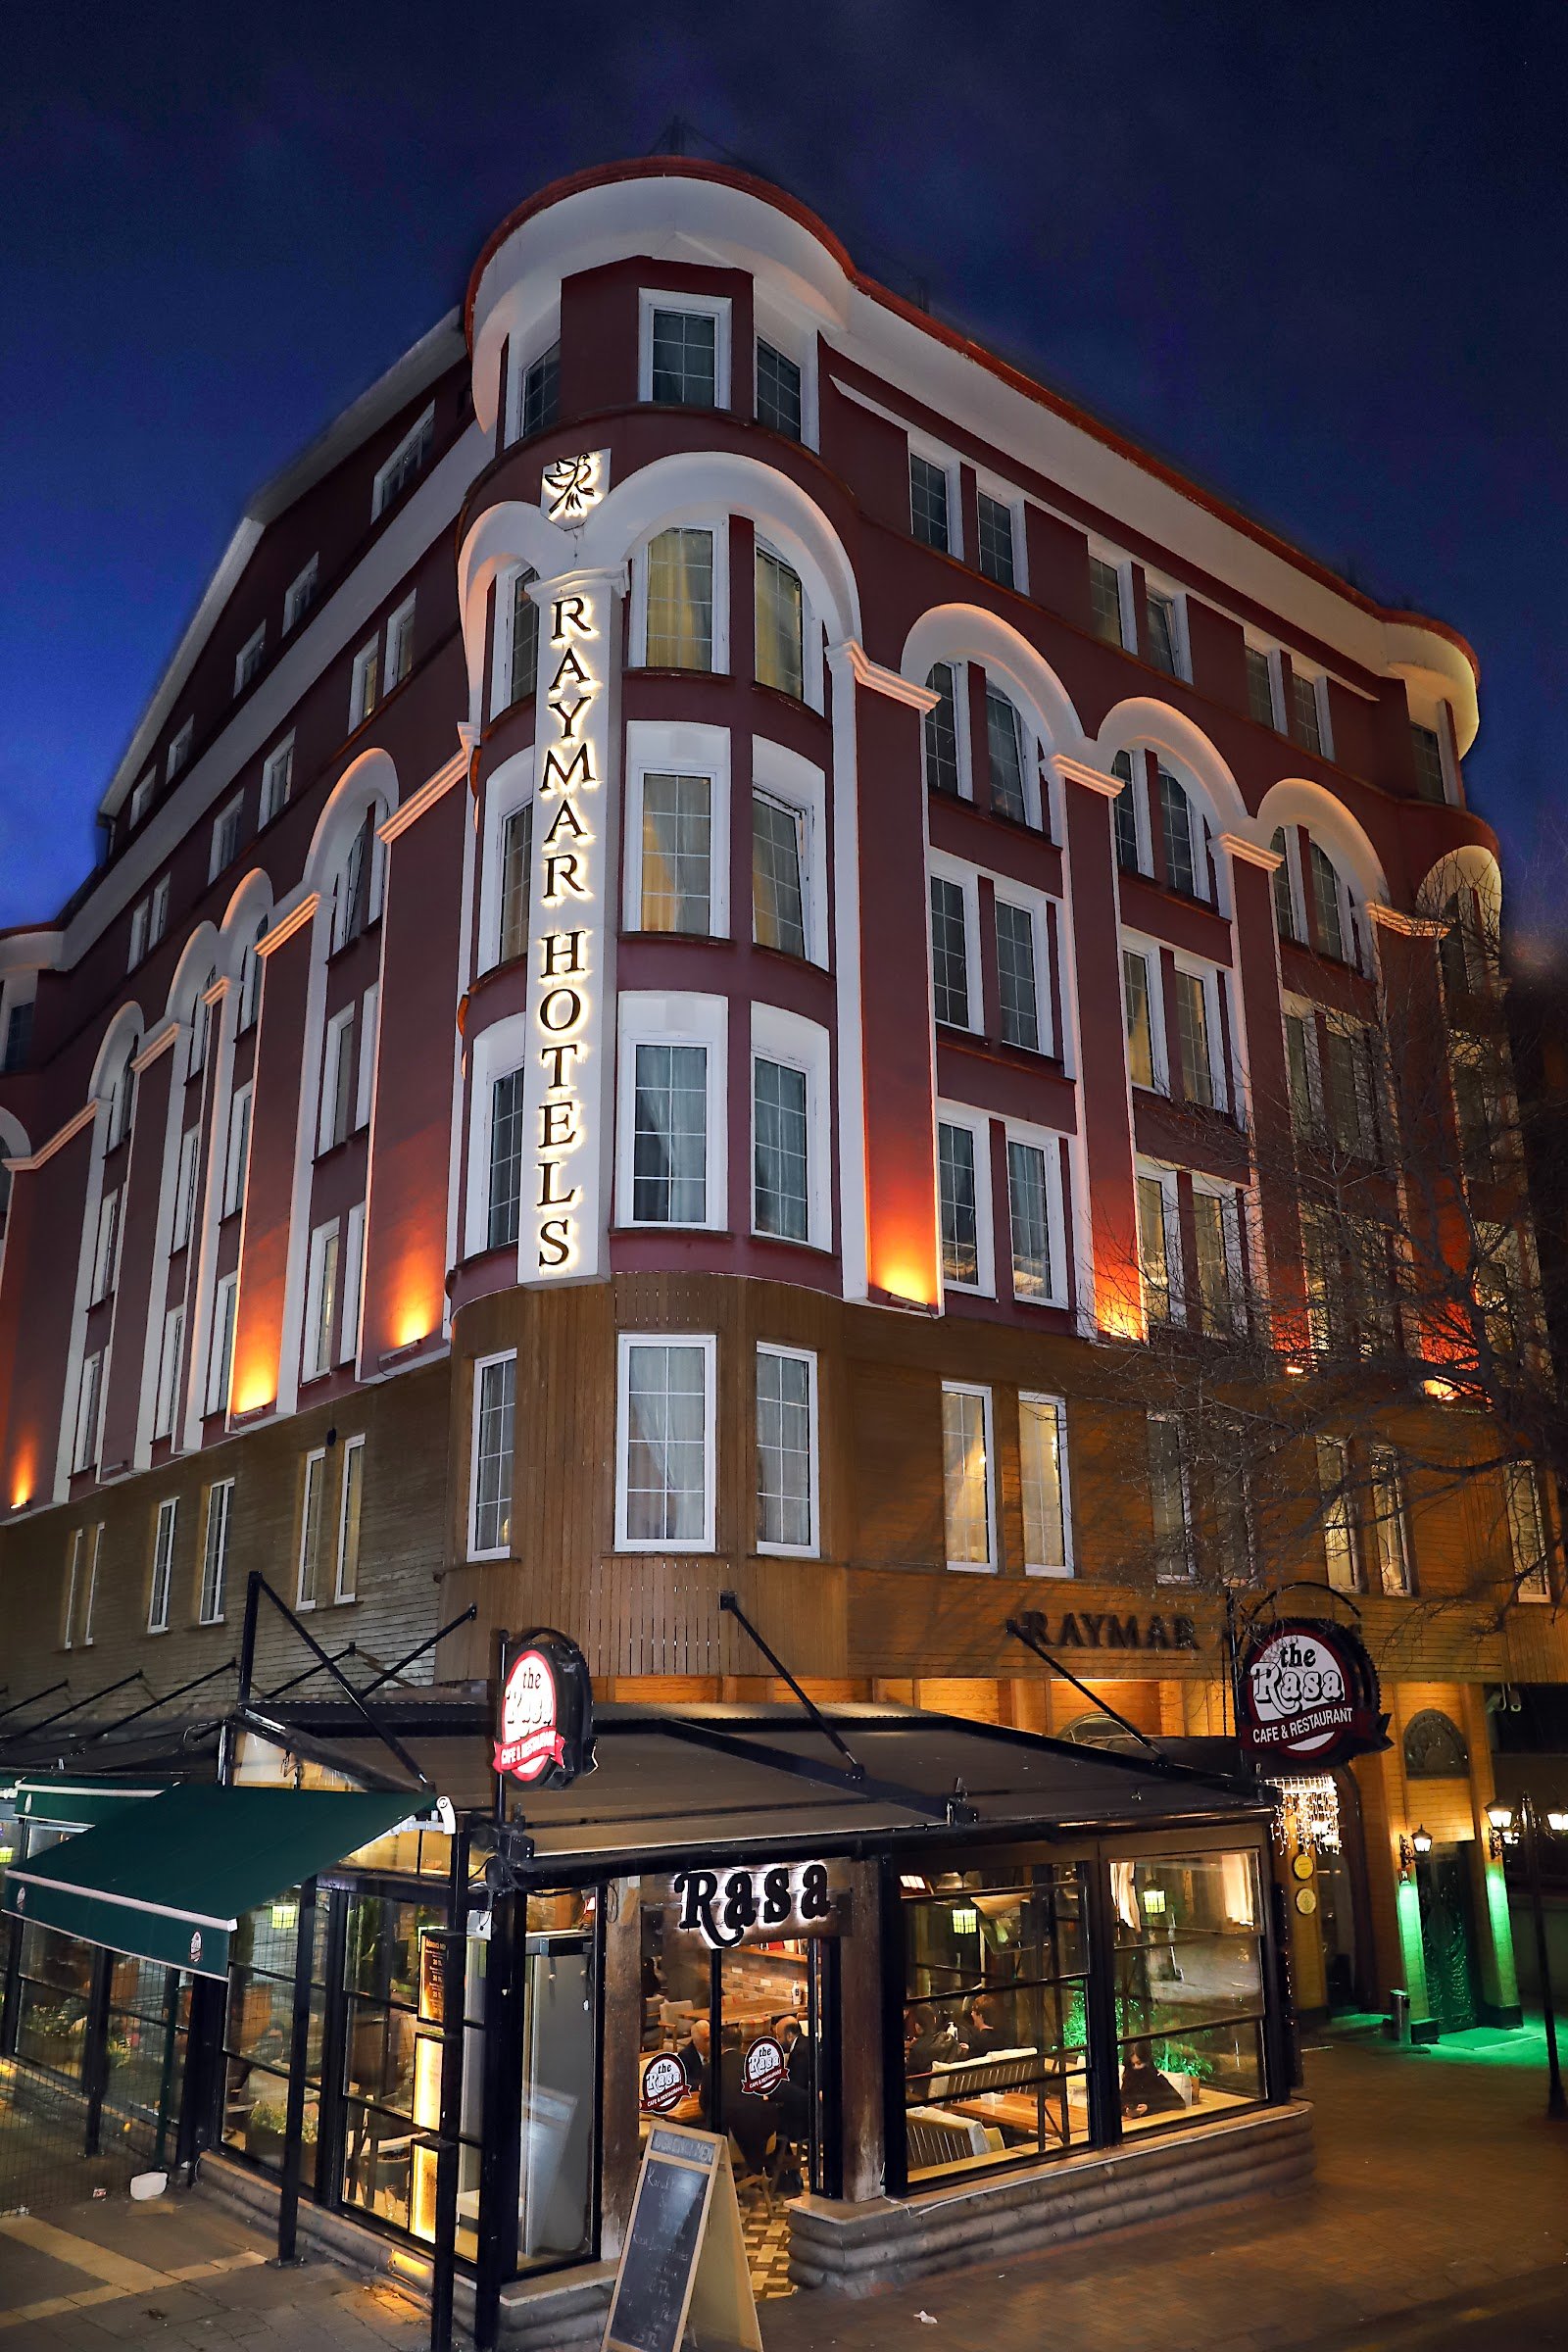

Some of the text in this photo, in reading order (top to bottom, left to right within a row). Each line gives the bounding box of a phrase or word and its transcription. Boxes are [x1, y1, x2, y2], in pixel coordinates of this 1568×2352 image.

[539, 598, 599, 899] RAYMAR
[537, 930, 587, 1267] HOTELS
[1020, 1611, 1201, 1650] RAYMAR
[1279, 1642, 1317, 1668] the
[522, 1667, 542, 1690] the
[1250, 1662, 1345, 1715] Rasa
[1253, 1707, 1353, 1743] CAFE & RESTAURANT
[673, 1864, 831, 1947] Rasa
[658, 2063, 672, 2075] the
[759, 2046, 772, 2058] the
